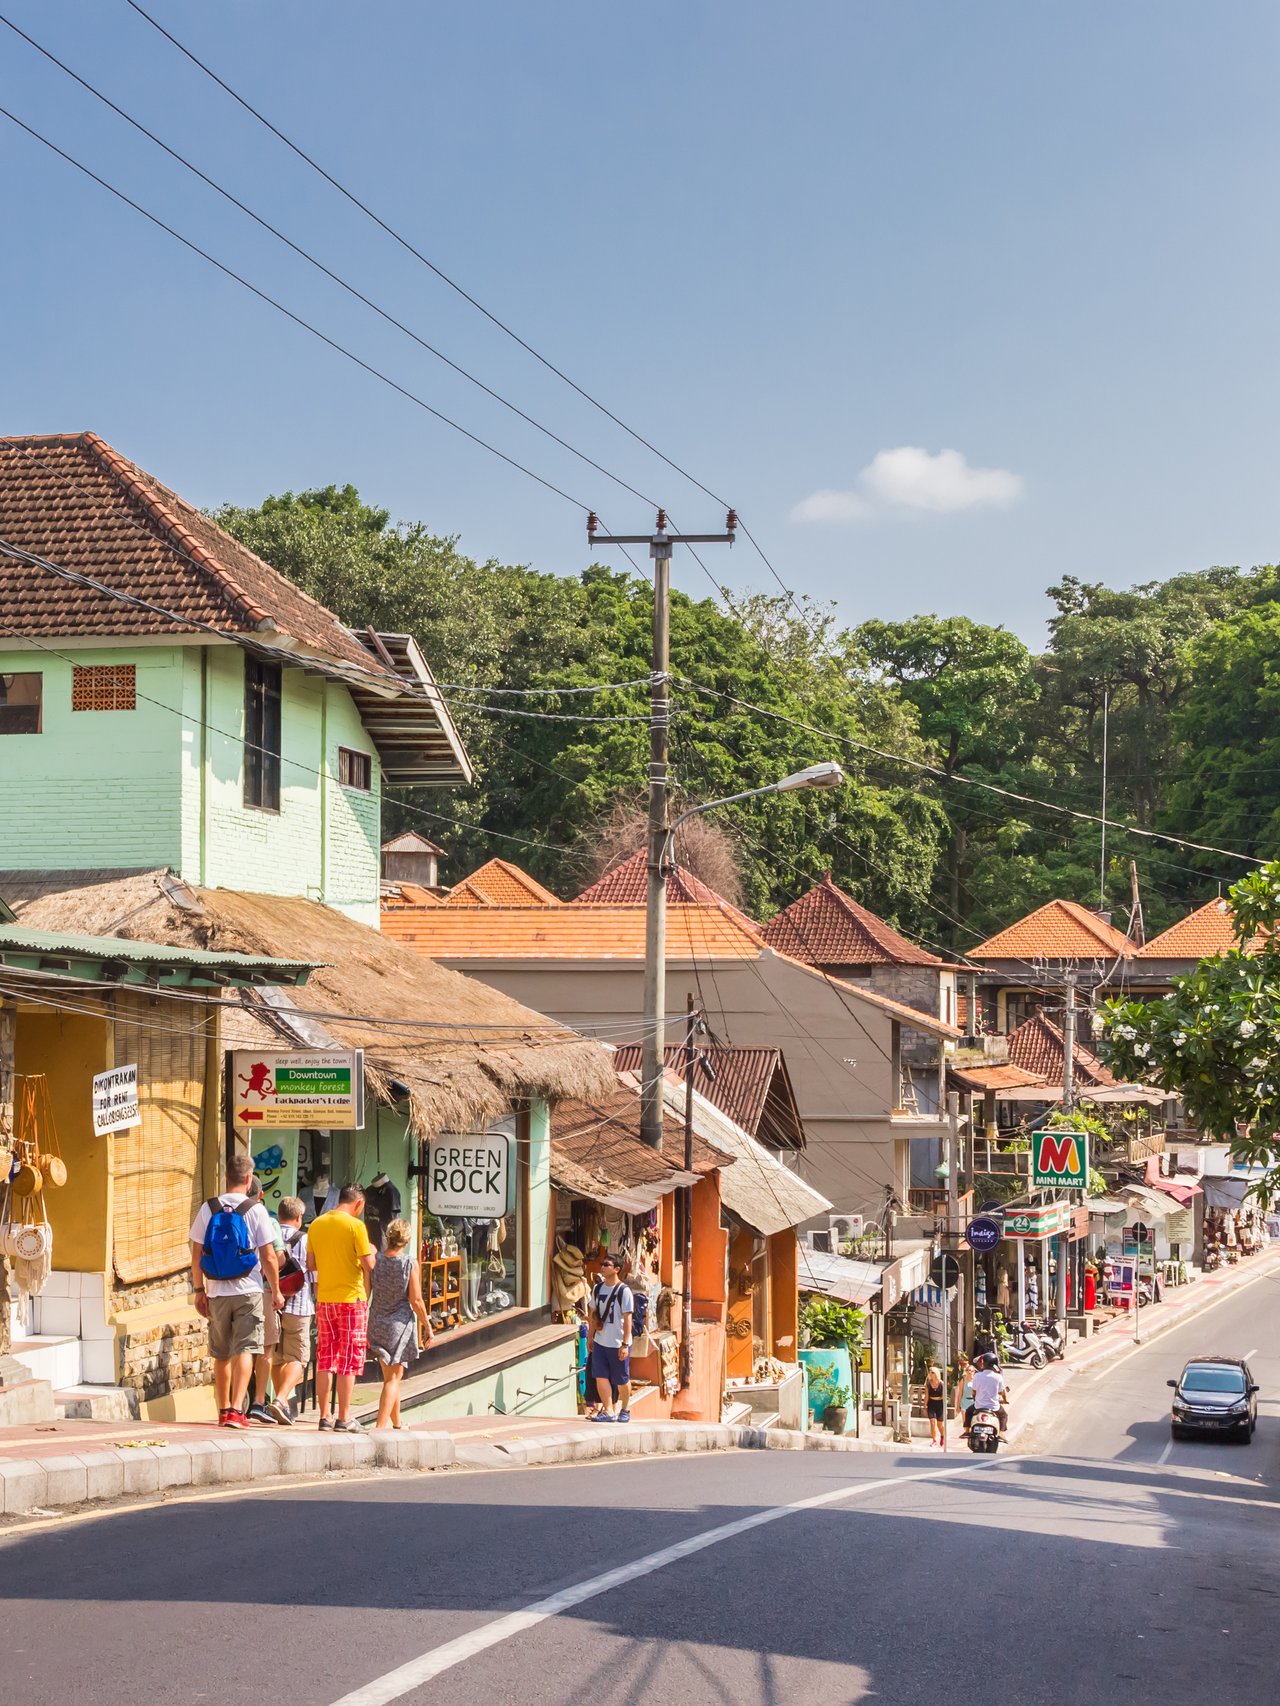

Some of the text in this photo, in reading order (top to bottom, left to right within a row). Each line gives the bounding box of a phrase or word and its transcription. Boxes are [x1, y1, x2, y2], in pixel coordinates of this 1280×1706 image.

[275, 1058, 288, 1066] sleep
[305, 1058, 320, 1066] enjoy
[289, 1070, 337, 1079] Downtown
[280, 1081, 345, 1094] monkey forest
[100, 1091, 128, 1110] FOR RENT
[275, 1097, 327, 1105] Backpacker's
[434, 1147, 501, 1168] GREEN
[433, 1168, 501, 1194] ROCK
[1035, 1176, 1084, 1186] MINI MART
[1015, 1217, 1029, 1227] 24
[970, 1227, 995, 1239] Indigo
